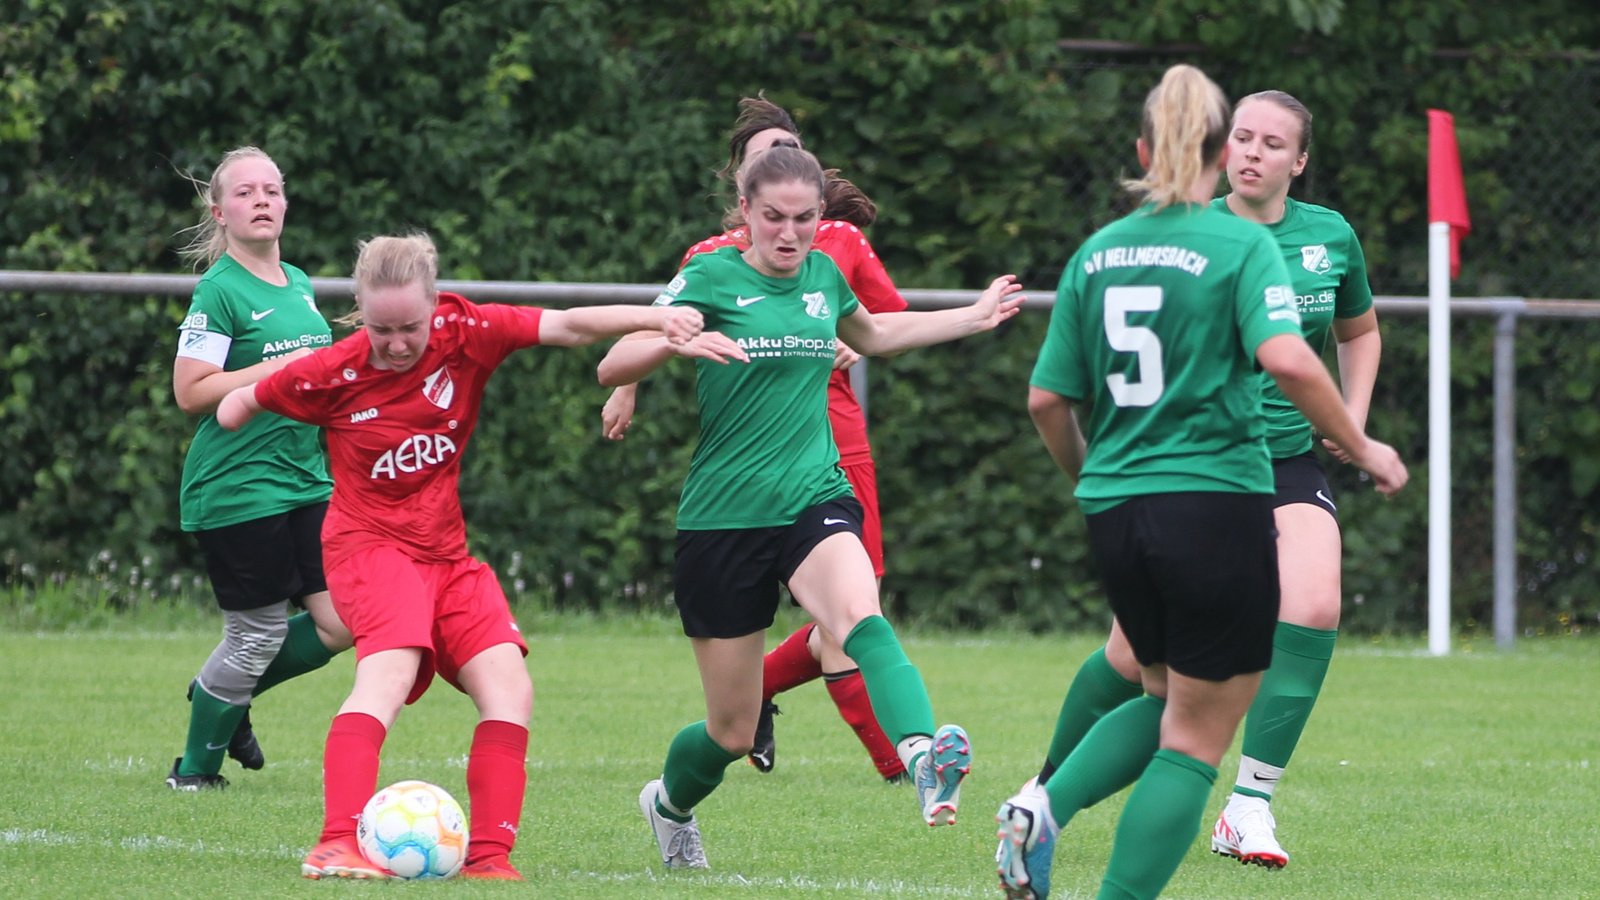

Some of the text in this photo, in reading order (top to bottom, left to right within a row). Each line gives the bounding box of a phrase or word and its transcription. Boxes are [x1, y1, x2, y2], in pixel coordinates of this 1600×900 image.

[1105, 246, 1209, 277] NELLMERSBACH
[1104, 286, 1164, 407] 5
[350, 407, 378, 424] JAKO
[370, 433, 457, 479] AERA
